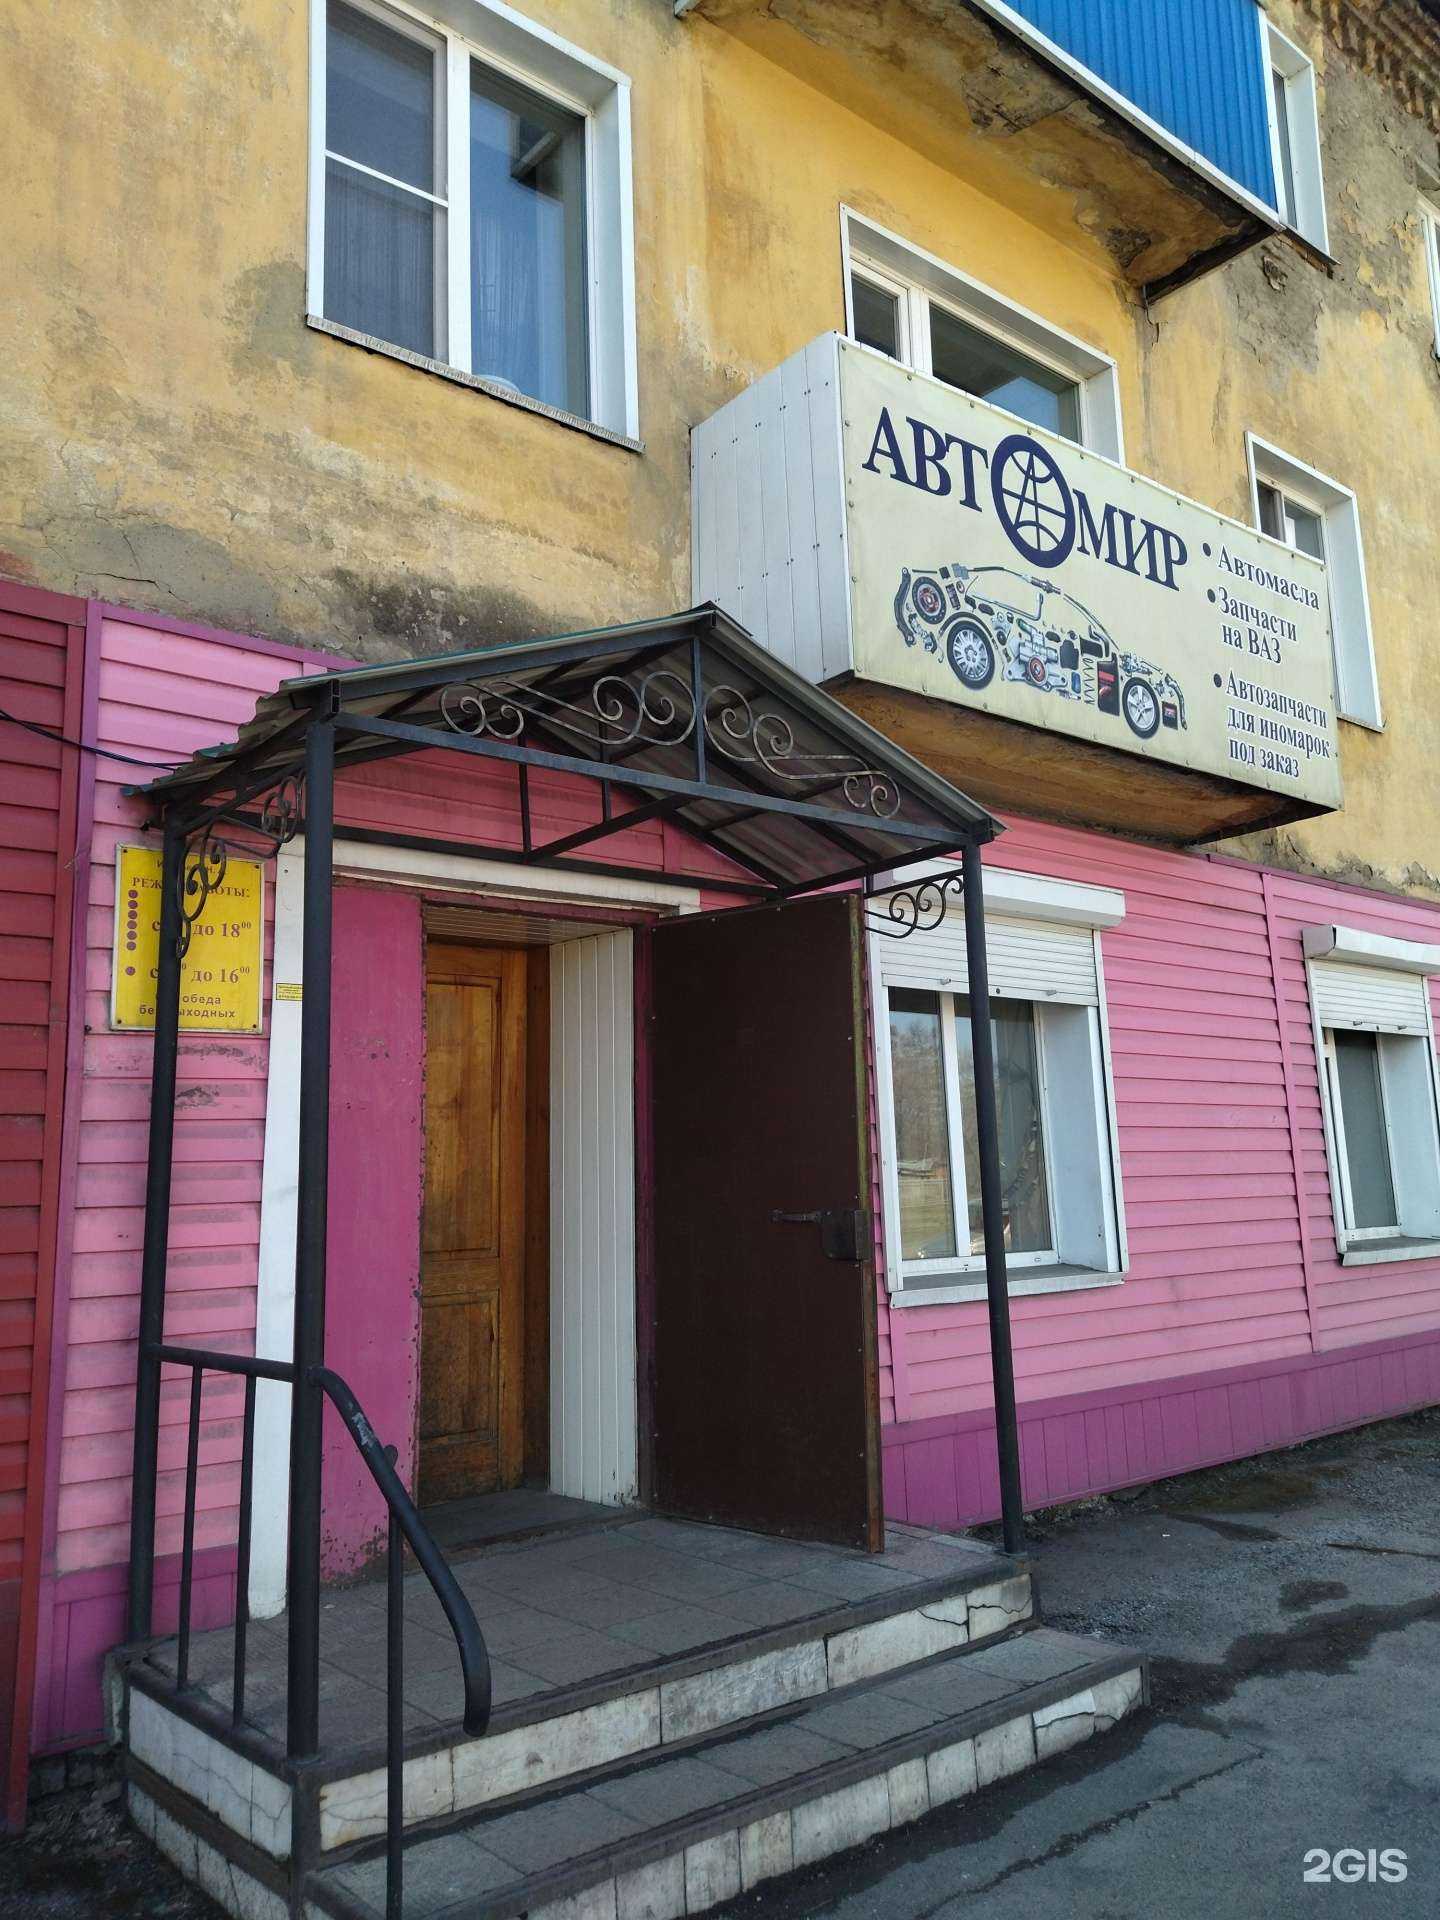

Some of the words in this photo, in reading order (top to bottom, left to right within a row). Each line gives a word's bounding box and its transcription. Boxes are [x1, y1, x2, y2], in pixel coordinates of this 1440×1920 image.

[861, 406, 1188, 592] АВТОМИР
[1218, 545, 1320, 610] Автомасла
[1218, 586, 1297, 642] Запчасти
[1221, 624, 1243, 650] на
[1247, 627, 1282, 664] ВАЗ
[1226, 669, 1327, 729] Автозапчасти
[1227, 707, 1256, 734] для
[1259, 717, 1330, 759] иномарок
[1229, 739, 1256, 766] под
[1259, 748, 1300, 778] заказ
[192, 924, 214, 936] до
[191, 969, 213, 982] до
[178, 1007, 235, 1018] ыходных
[182, 993, 222, 1005] обеда
